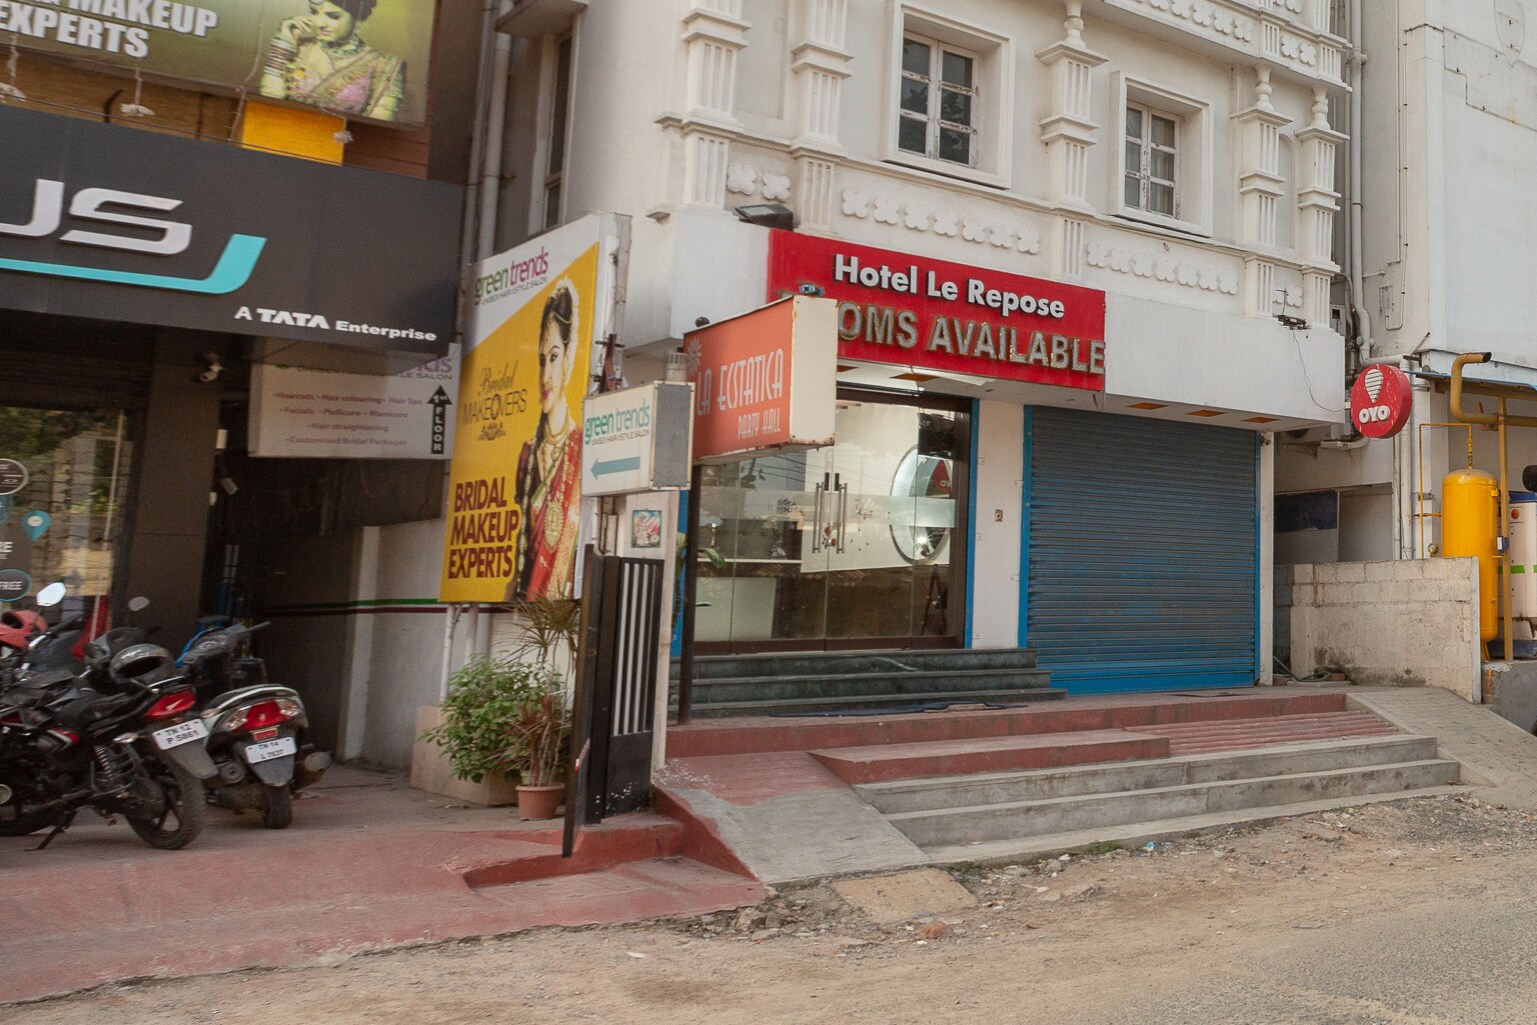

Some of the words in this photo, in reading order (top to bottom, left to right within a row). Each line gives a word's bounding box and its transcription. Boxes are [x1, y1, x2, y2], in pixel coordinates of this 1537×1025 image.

[0, 0, 149, 59] EXPERTS
[474, 267, 508, 306] green
[509, 245, 549, 286] trends
[834, 253, 918, 294] Hotel
[926, 270, 958, 301] Le
[967, 278, 1065, 319] Repose
[234, 306, 253, 321] A
[257, 307, 331, 330] TATA
[335, 320, 437, 343] Enterprise
[837, 301, 918, 350] OMS
[926, 315, 1106, 375] AVAILABLE
[696, 368, 712, 416] LA
[1358, 405, 1391, 424] OYO
[585, 412, 614, 445] green
[615, 398, 650, 433] trends
[454, 476, 507, 512] BRIDAL
[450, 509, 519, 546] MAKEUP
[447, 547, 513, 579] EXPERTS
